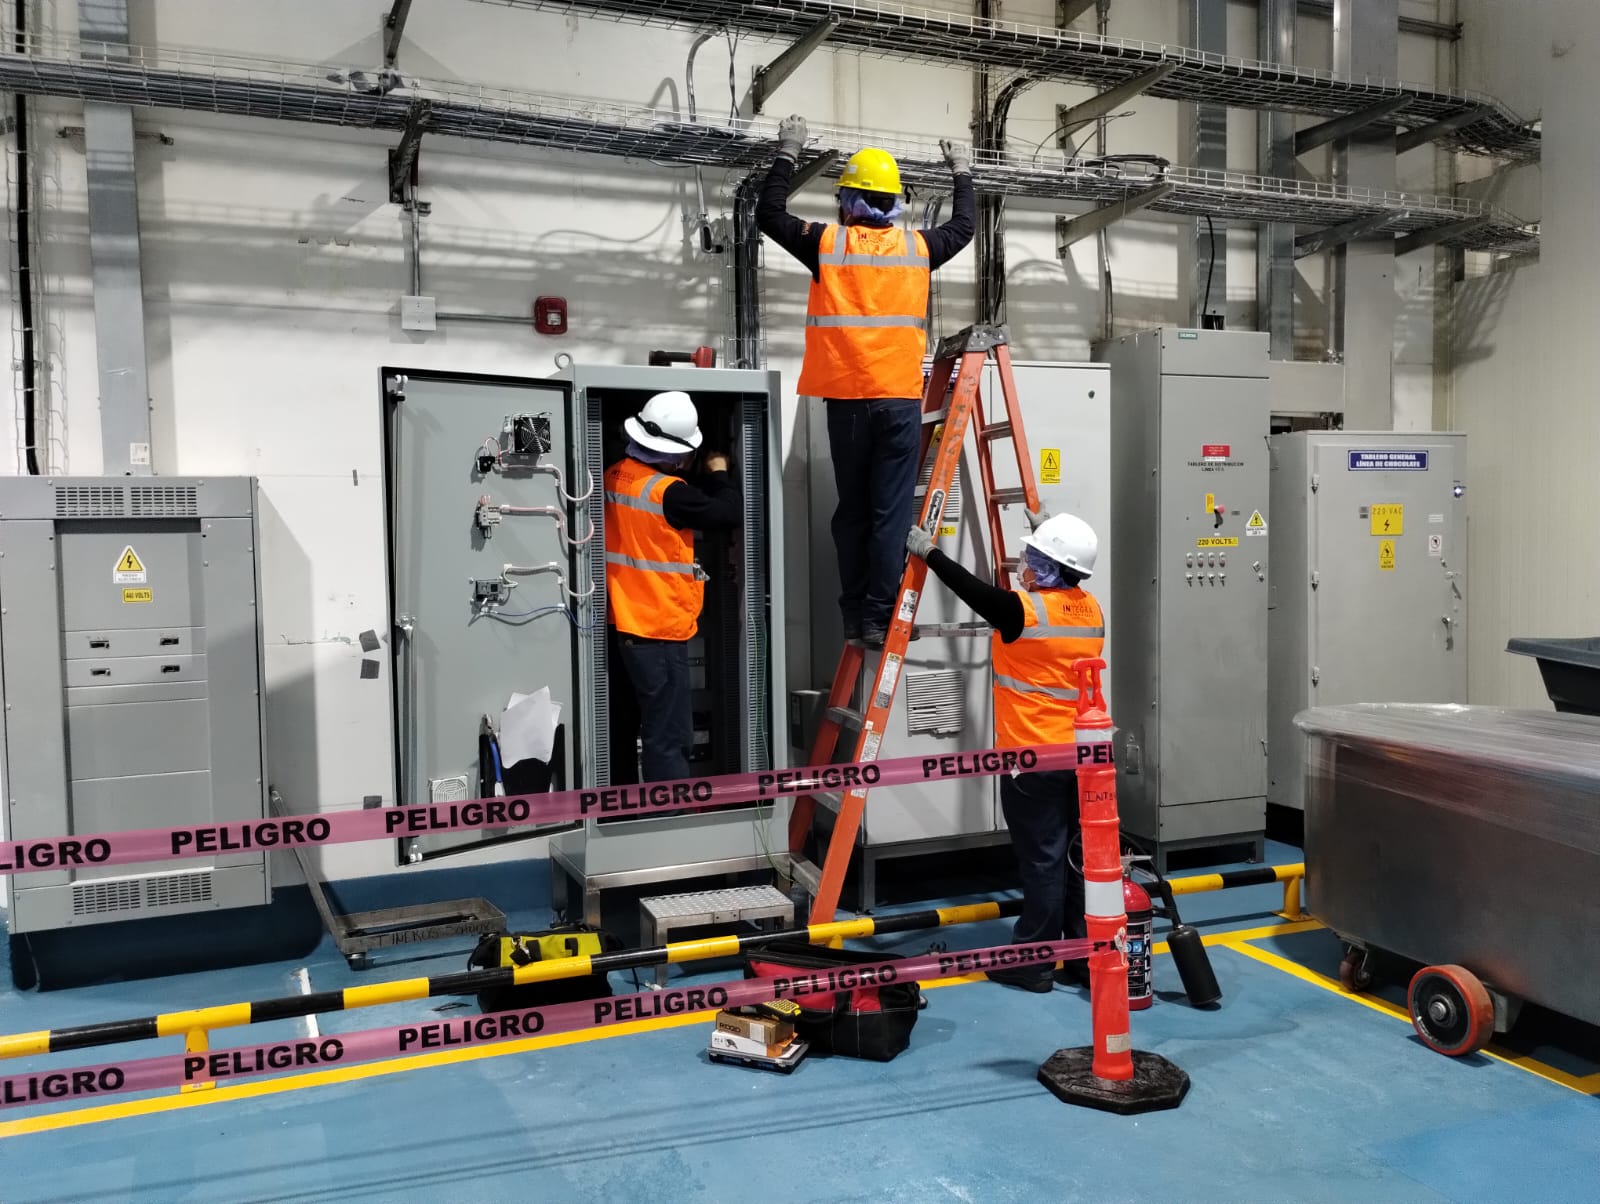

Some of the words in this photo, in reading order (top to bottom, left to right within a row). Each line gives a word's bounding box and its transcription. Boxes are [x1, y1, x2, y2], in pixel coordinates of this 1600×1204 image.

[1372, 507, 1386, 515] 220
[1389, 507, 1403, 515] VAC
[1211, 538, 1232, 546] VOLTS
[171, 817, 331, 855] PELIGRO
[385, 799, 530, 834] PELIGRO
[580, 781, 713, 814] PELIGRO
[758, 764, 881, 795] PELIGRO
[922, 749, 1037, 778] PELIGRO
[184, 1039, 344, 1080] PELIGRO
[399, 1011, 545, 1051] PELIGRO
[594, 986, 728, 1024] PELIGRO
[773, 964, 898, 999] PELIGRO
[938, 944, 1055, 974] PELIGRO
